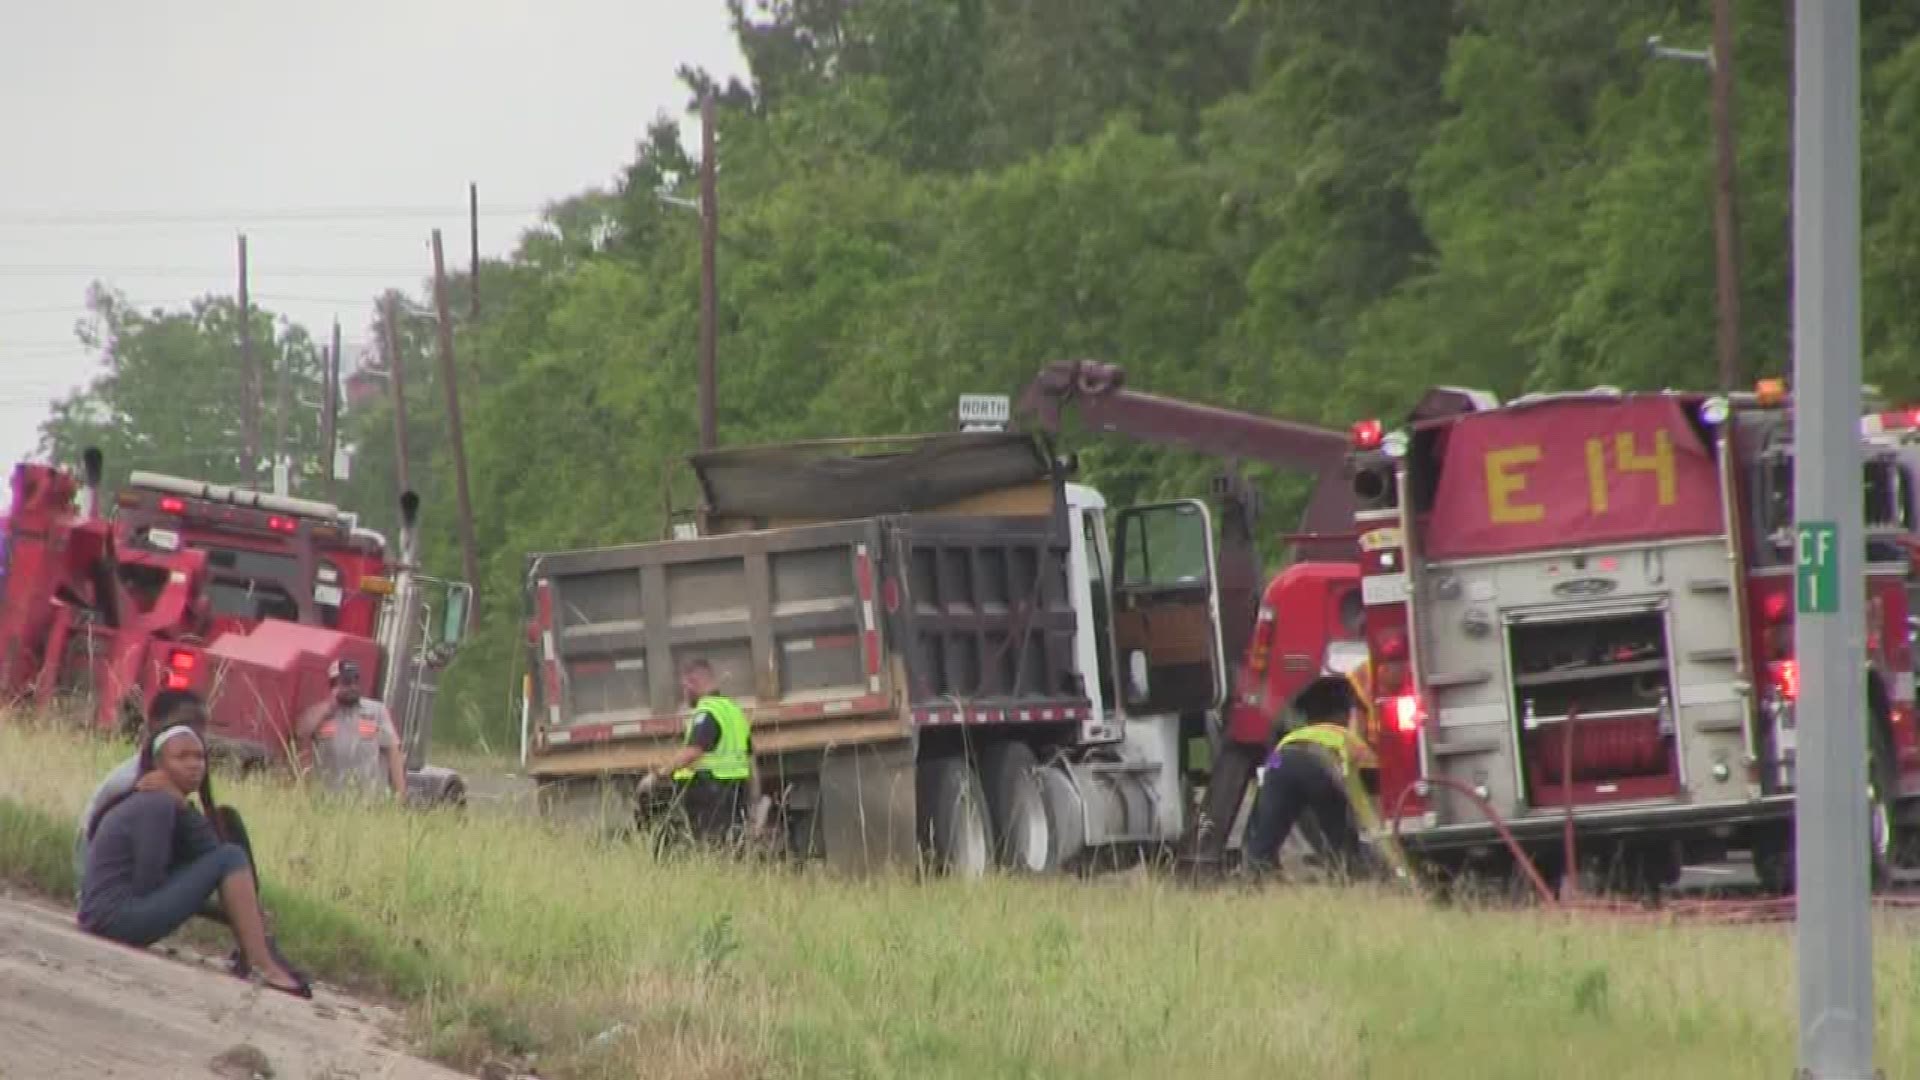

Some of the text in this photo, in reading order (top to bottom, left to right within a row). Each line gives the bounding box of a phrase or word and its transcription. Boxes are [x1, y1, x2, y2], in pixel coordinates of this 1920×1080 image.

[962, 400, 1007, 416] NORTH
[1486, 429, 1676, 523] E 14
[1799, 529, 1834, 566] CF
[1808, 574, 1818, 610] 1
